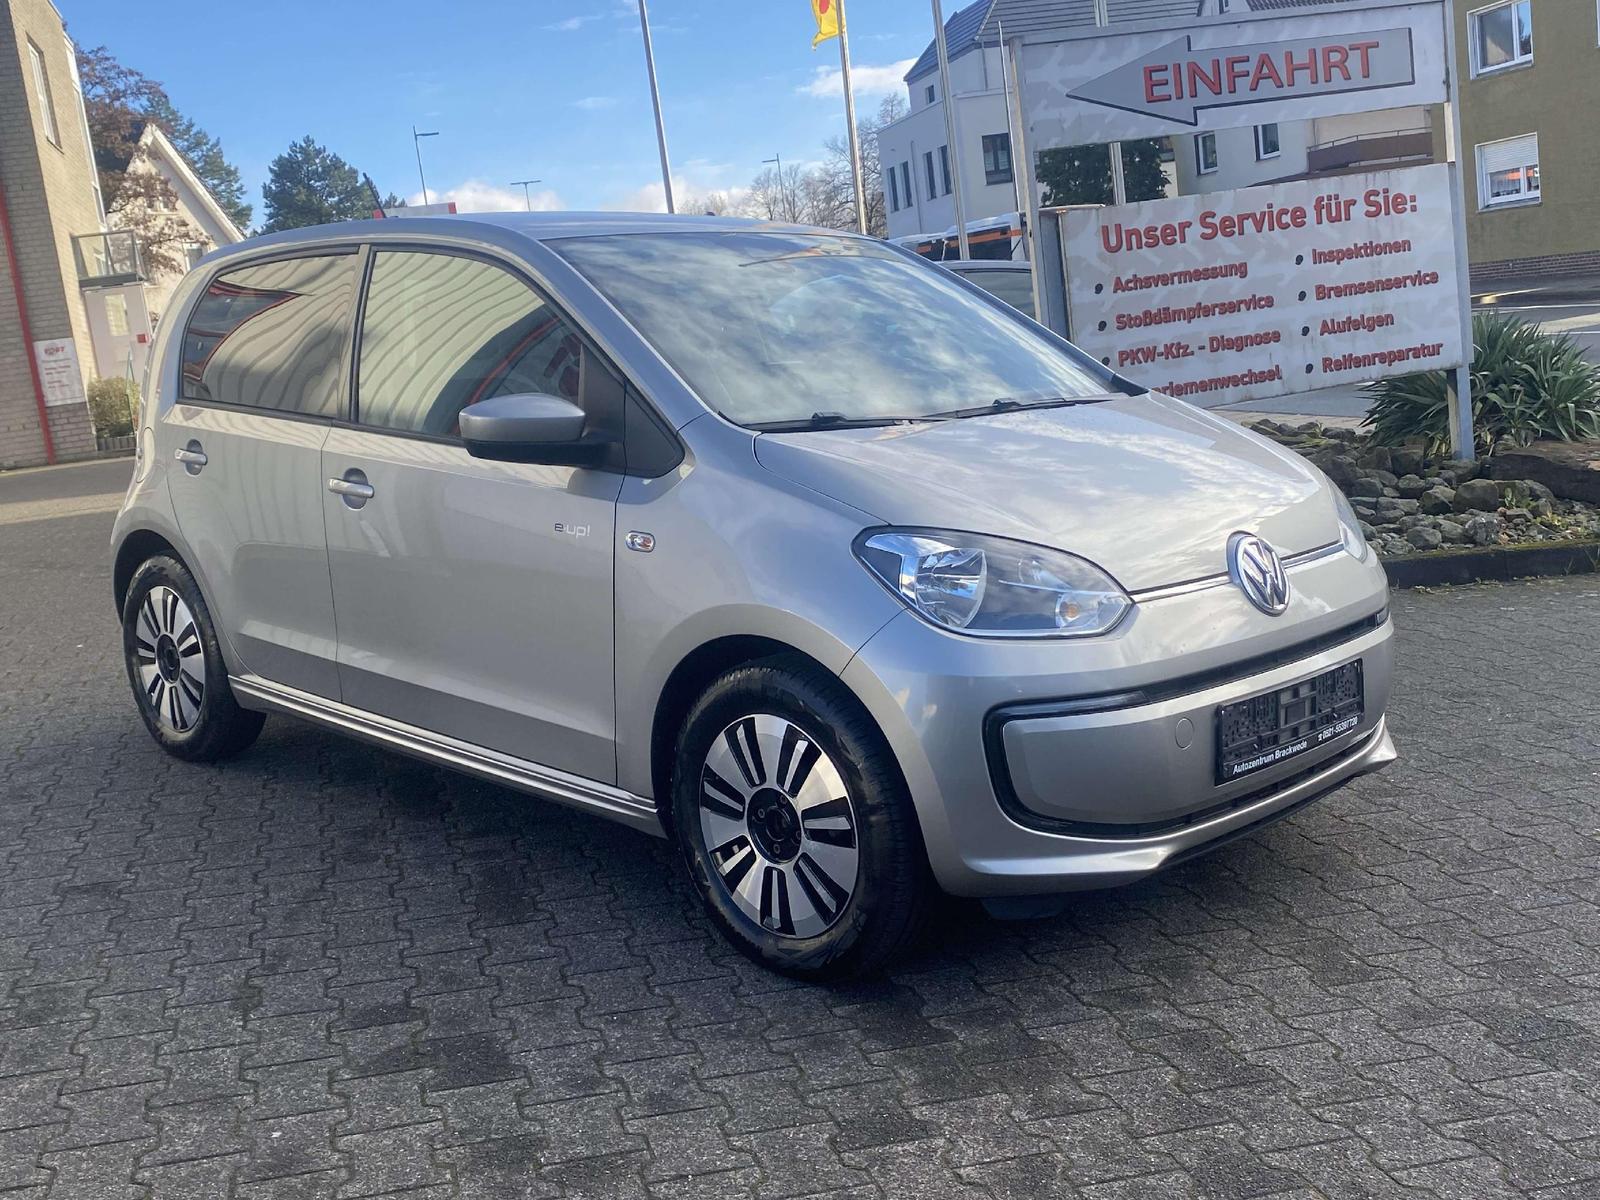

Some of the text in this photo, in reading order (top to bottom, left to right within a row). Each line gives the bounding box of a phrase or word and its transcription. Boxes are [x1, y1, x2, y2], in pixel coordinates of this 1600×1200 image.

[1143, 41, 1380, 103] EINFAHRT
[1102, 188, 1418, 254] Unser Service für Sie:
[1311, 238, 1411, 266] Inspektionen
[1112, 261, 1248, 294] Achsvermessung
[1314, 270, 1439, 301] Bremsenservice
[1115, 293, 1275, 331] Stoßdämpferservice
[1319, 312, 1395, 337] Alufelgen
[1208, 328, 1281, 354] Diagnose
[1321, 341, 1443, 374] Reifenreparatur
[1232, 753, 1275, 775] Autozentrum
[1275, 740, 1308, 760] Brackwede
